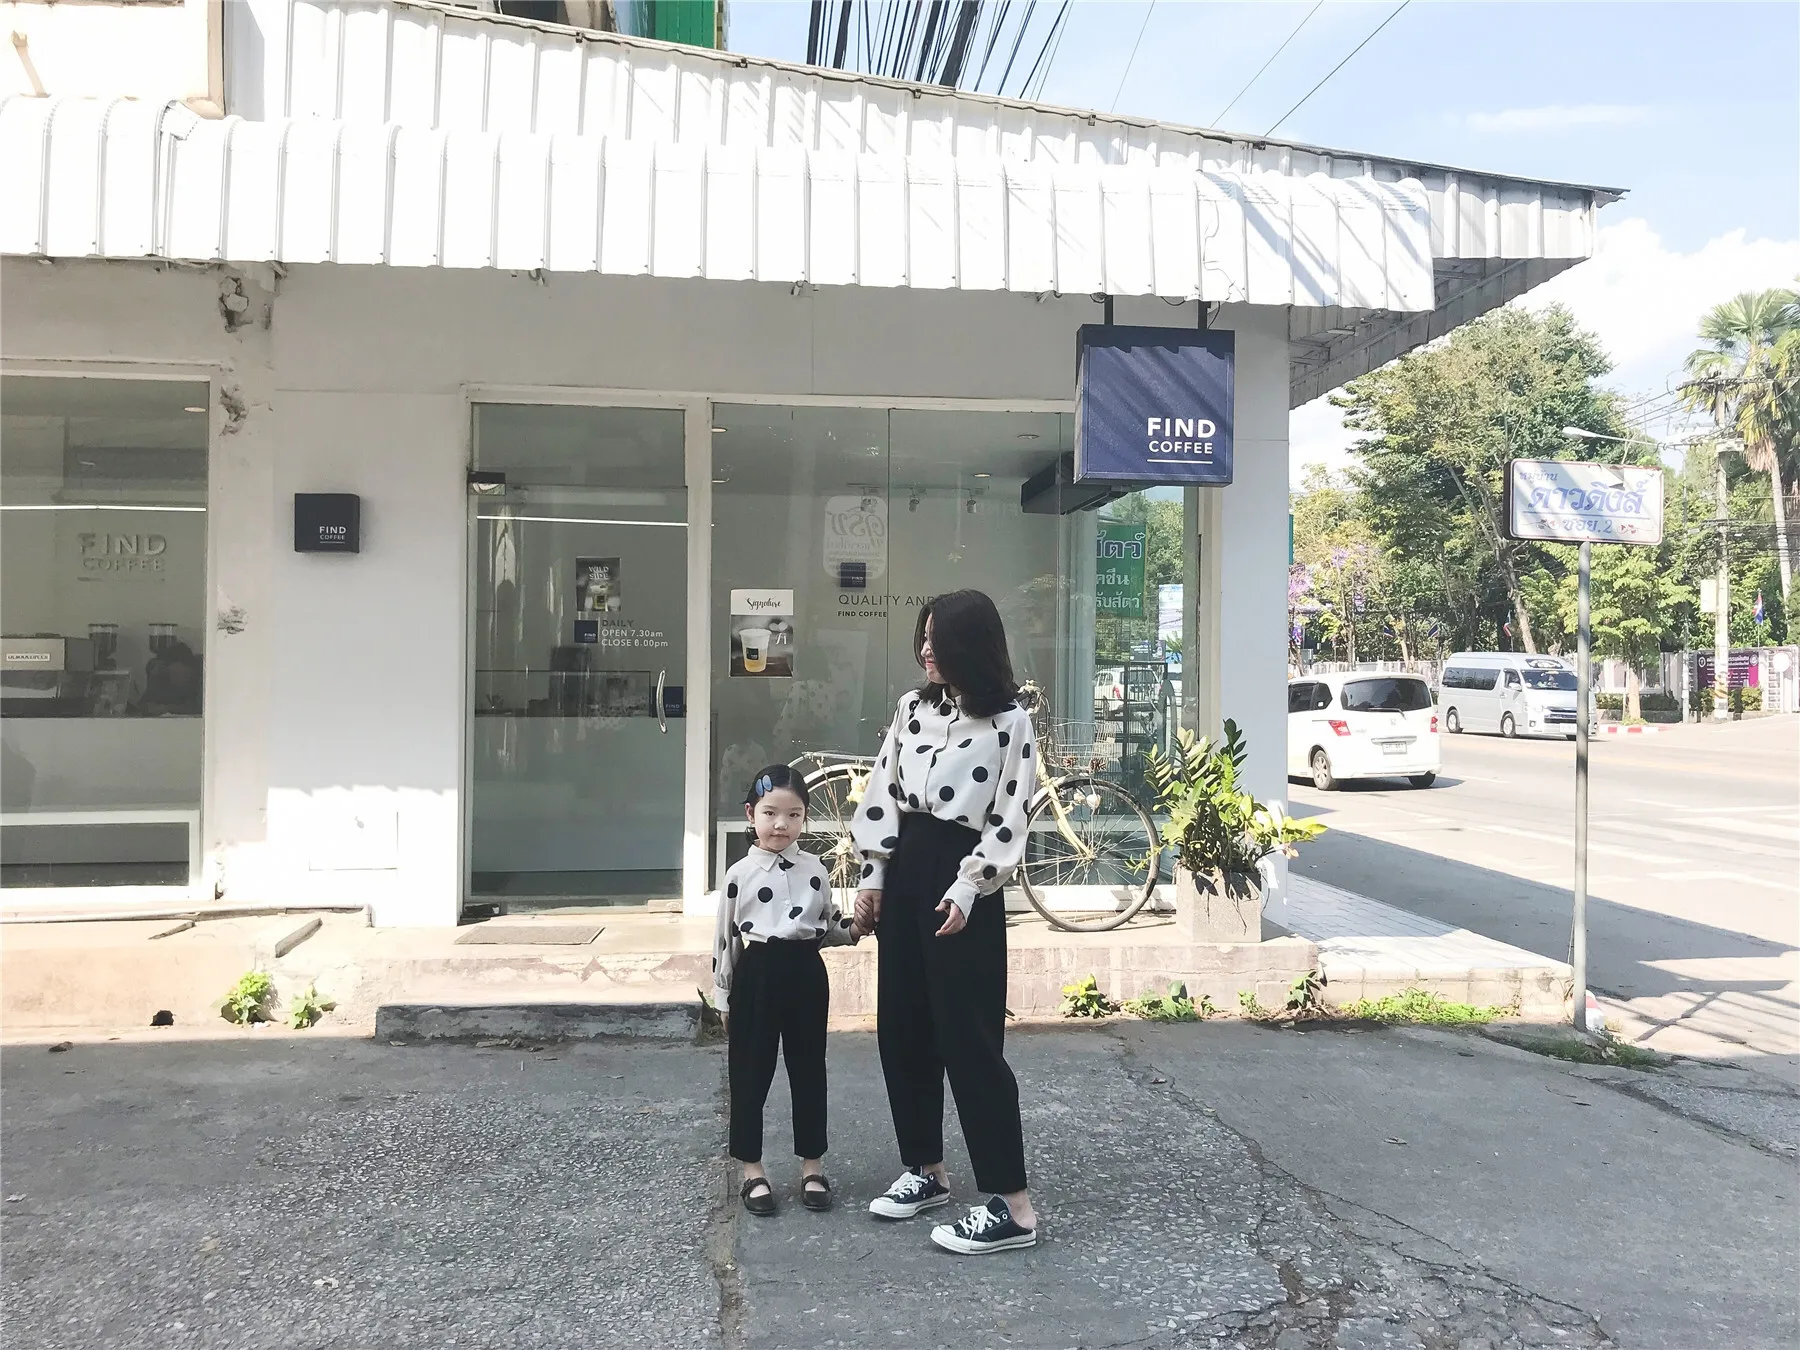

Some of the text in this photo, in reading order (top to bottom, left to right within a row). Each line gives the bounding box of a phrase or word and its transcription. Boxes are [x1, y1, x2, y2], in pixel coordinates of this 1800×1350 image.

[1147, 417, 1216, 439] FIND
[1148, 440, 1213, 455] COFFEE
[319, 526, 347, 534] FIND
[78, 532, 167, 556] FIND
[82, 557, 166, 572] COFFEE
[838, 594, 901, 606] QUALITY
[837, 610, 856, 618] FIND
[602, 619, 634, 627] DAILY
[601, 629, 663, 638] OPEN 7.30am
[601, 638, 632, 647] CLOSE
